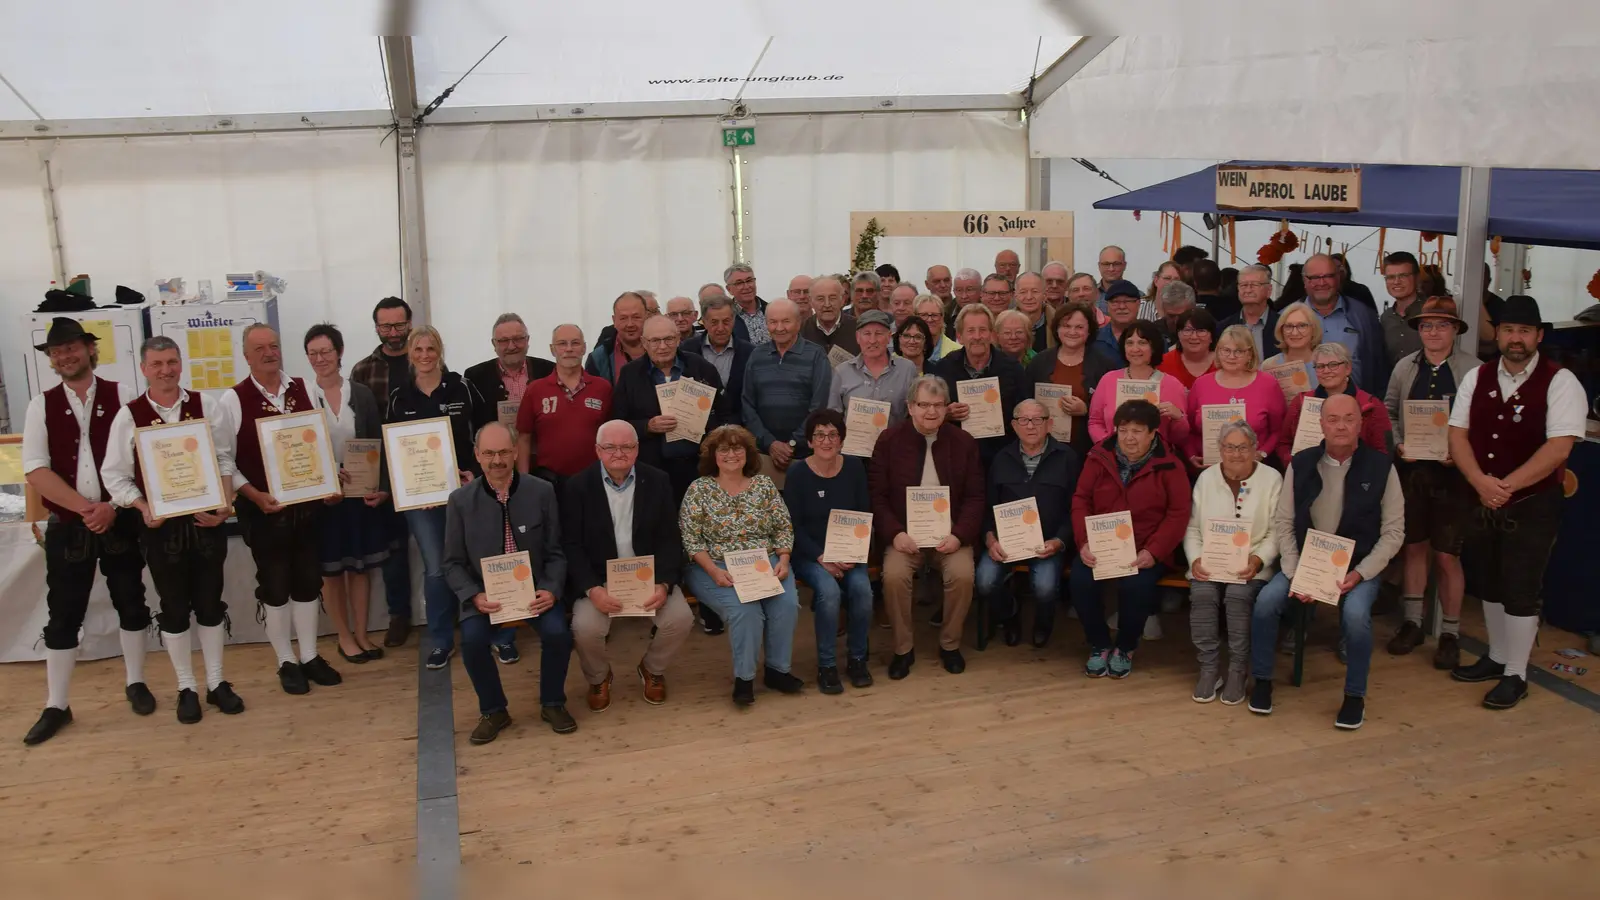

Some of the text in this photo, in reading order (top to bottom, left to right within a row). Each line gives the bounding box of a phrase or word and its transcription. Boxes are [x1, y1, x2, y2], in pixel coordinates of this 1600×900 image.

[648, 74, 845, 85] www.zelte-unglaub.de
[1218, 172, 1247, 187] WEIN
[1249, 182, 1347, 201] APEROL LAUBE
[963, 213, 1036, 235] 66 Jahre
[187, 318, 234, 328] Winkler
[542, 396, 557, 414] 87
[911, 491, 945, 502] Urkunde
